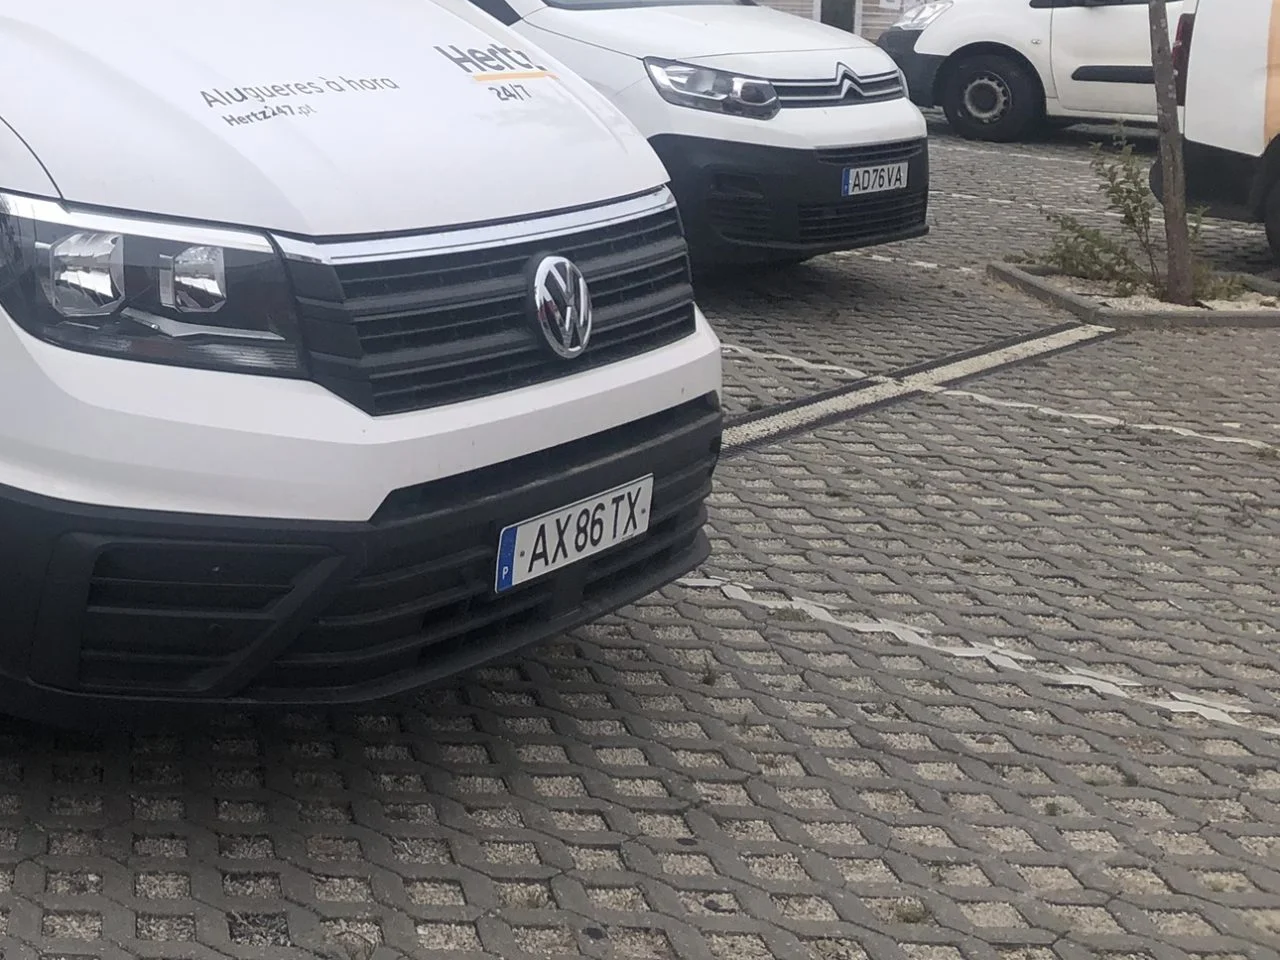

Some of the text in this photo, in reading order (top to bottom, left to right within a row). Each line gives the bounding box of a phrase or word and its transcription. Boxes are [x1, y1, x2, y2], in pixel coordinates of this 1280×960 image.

[200, 75, 401, 108] Alugueres à hora
[487, 83, 532, 101] 24/7
[221, 103, 318, 127] Hertz247.pt
